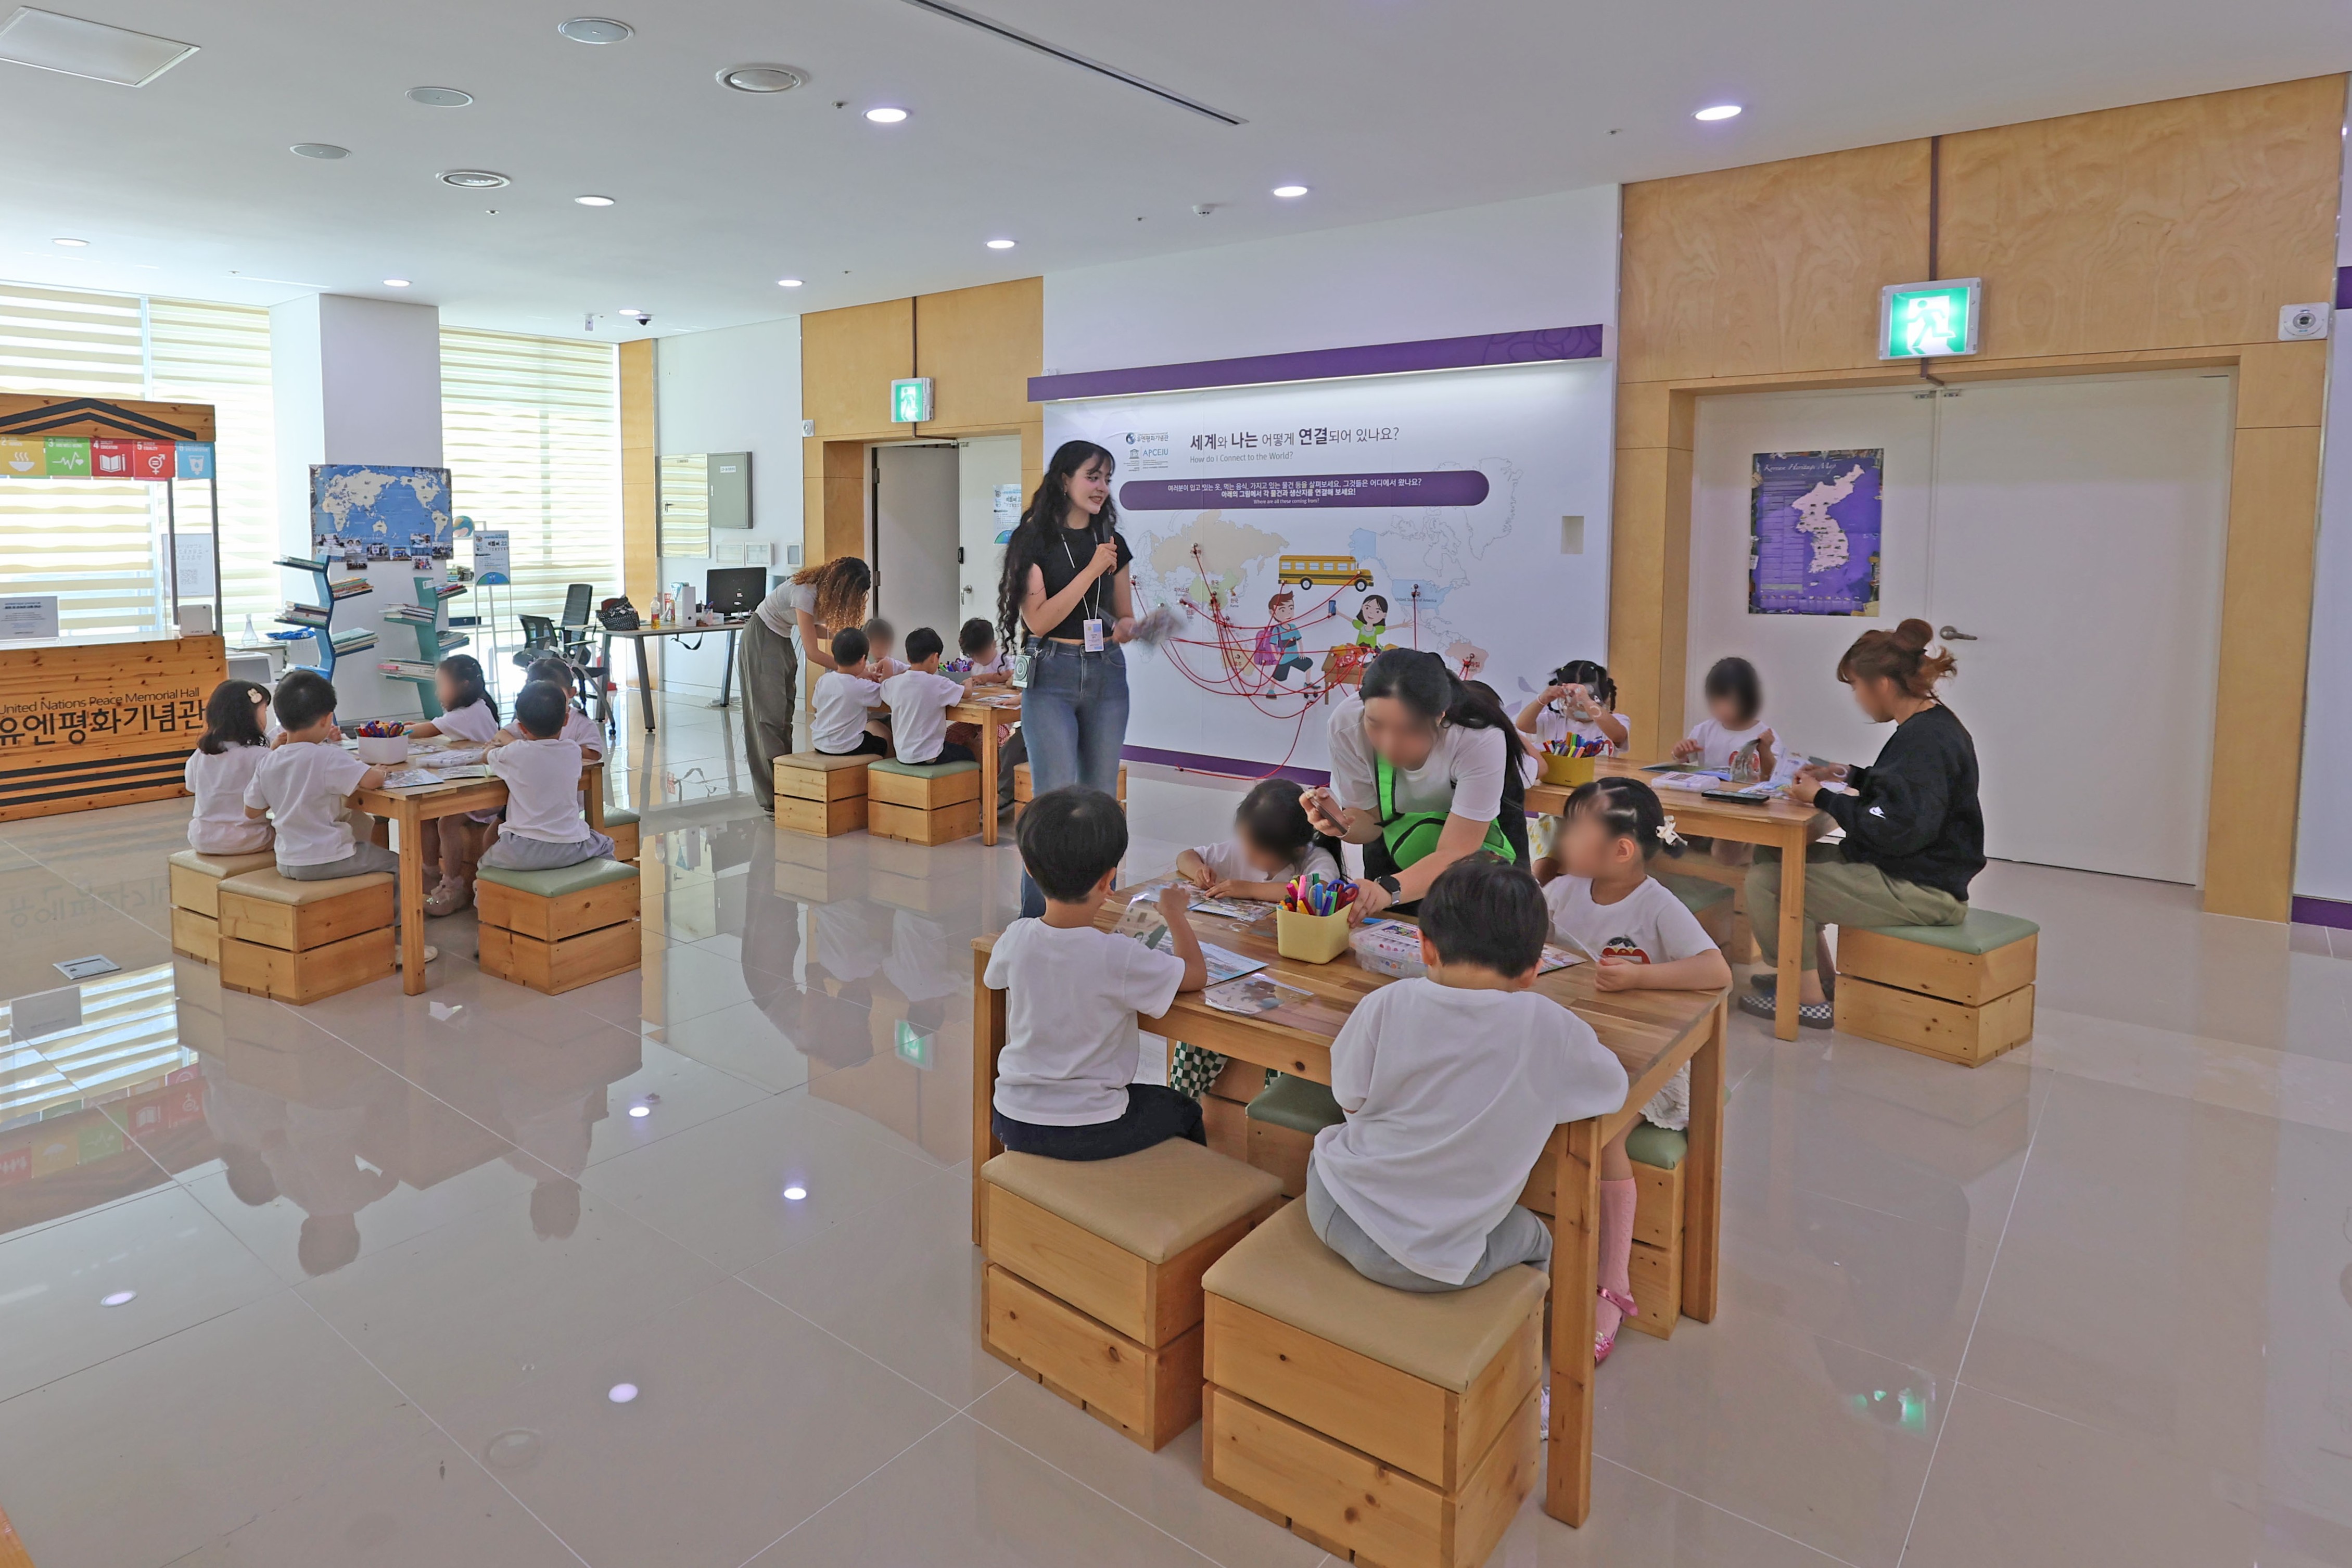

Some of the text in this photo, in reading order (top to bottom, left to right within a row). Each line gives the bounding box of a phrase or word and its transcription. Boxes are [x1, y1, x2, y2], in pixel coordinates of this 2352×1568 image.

[48, 438, 54, 447] 3
[1190, 427, 1399, 451] 세계와 나는 어떻게 연결되어 있나요?
[93, 440, 99, 449] 4
[137, 441, 142, 450] 5
[1143, 448, 1168, 457] APCEIU
[1269, 451, 1293, 460] World?
[1282, 481, 1294, 489] 물건
[1343, 479, 1368, 488] 그것들은
[1370, 478, 1396, 487] 어디에서
[1398, 478, 1422, 487] 왔나요?
[1239, 490, 1262, 498] 그림에서
[1289, 489, 1313, 497] 생산지를
[1315, 488, 1333, 496] 연결해
[1334, 488, 1356, 496] 보세요!
[40, 698, 86, 711] Nations
[89, 695, 123, 706] Peace
[125, 690, 177, 703] Memorial
[181, 687, 200, 699] Hall
[0, 699, 205, 746] 유엔평화기념관
